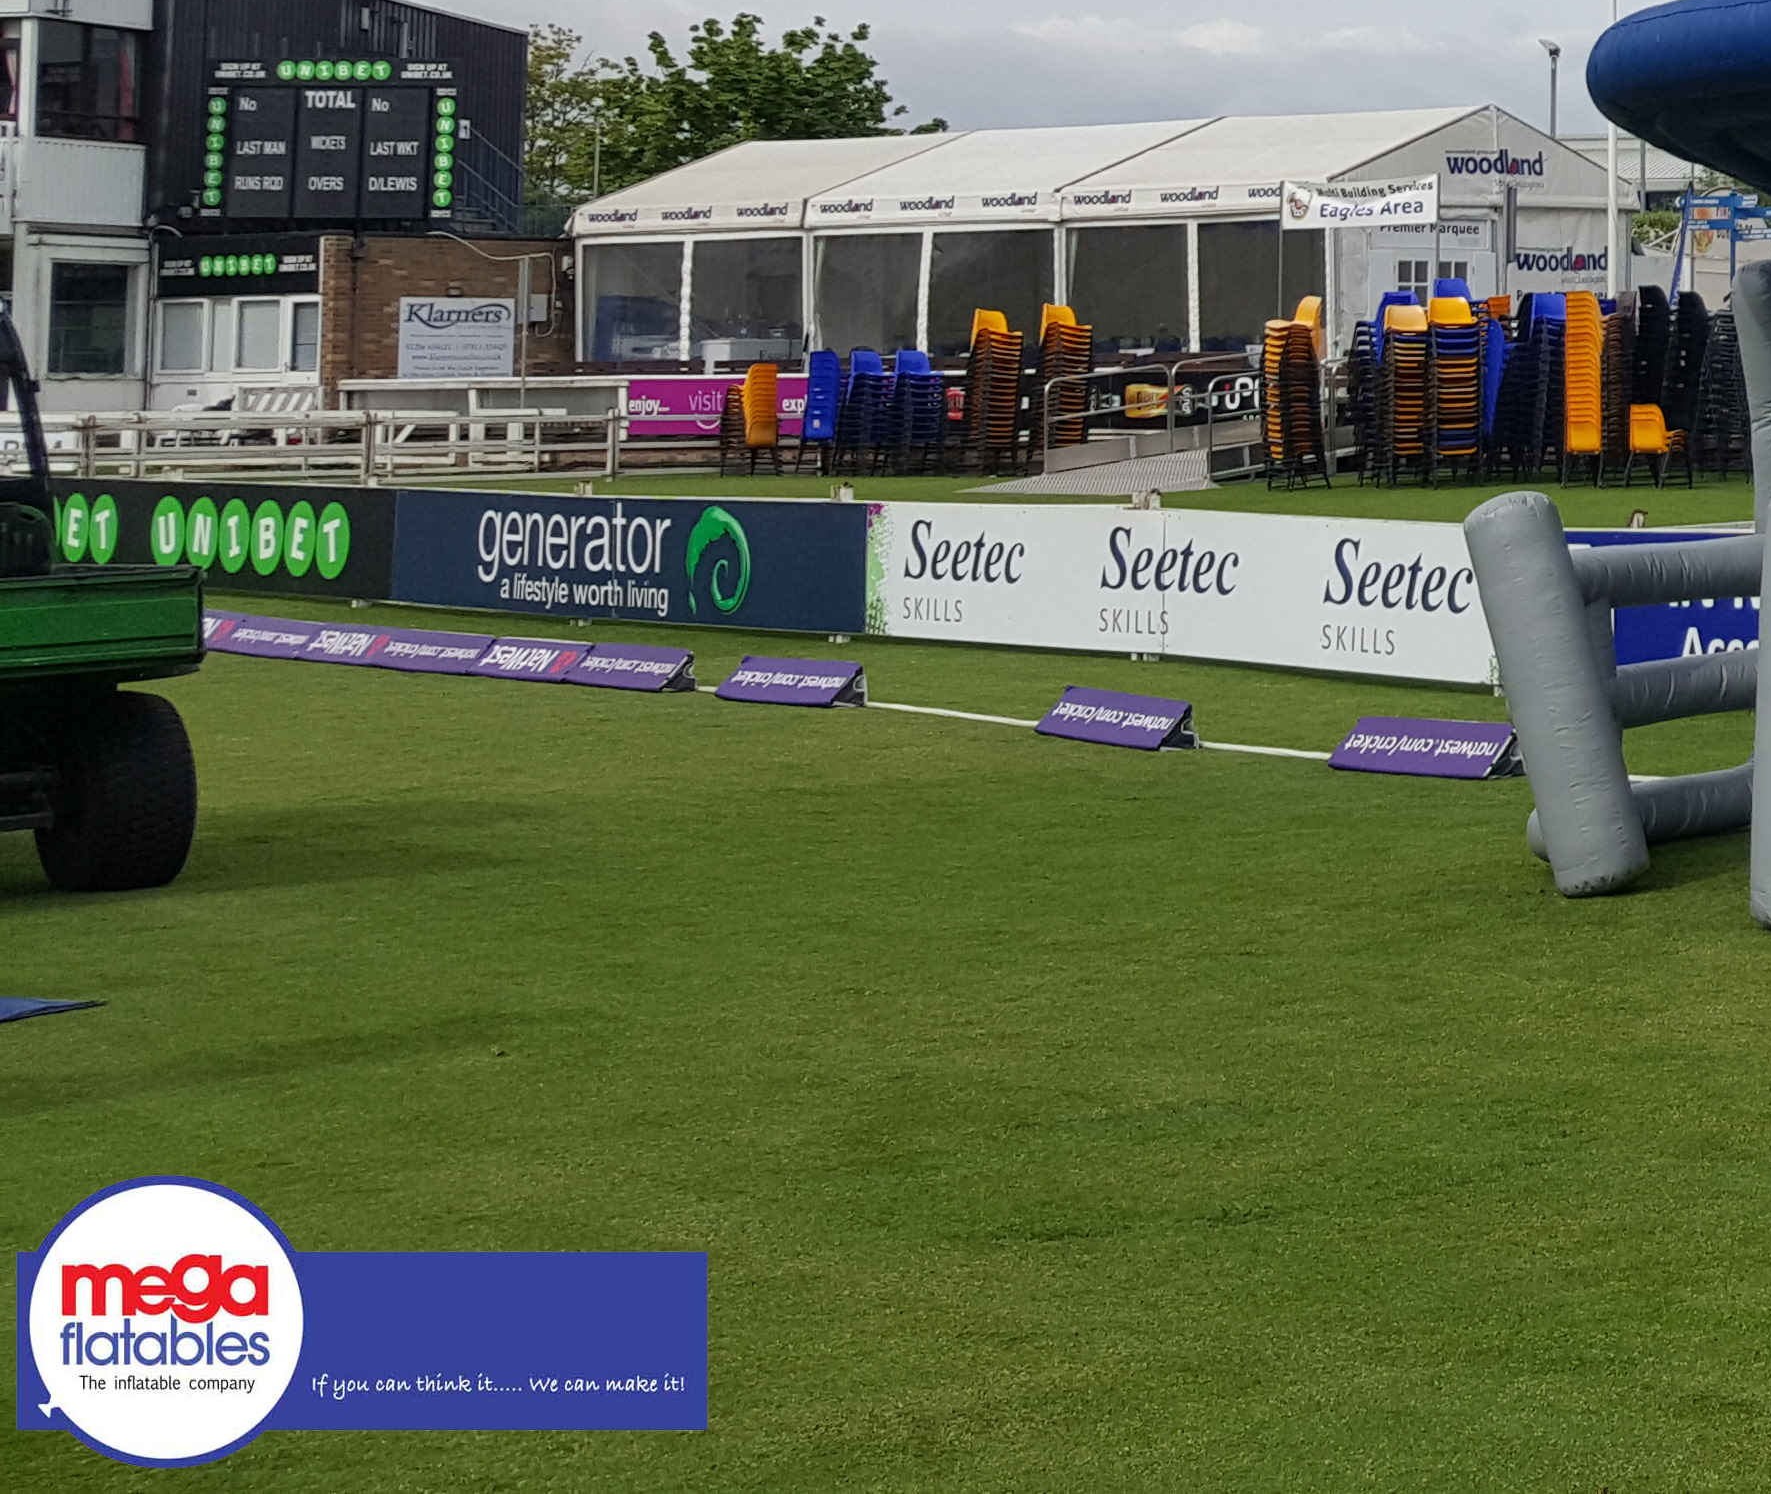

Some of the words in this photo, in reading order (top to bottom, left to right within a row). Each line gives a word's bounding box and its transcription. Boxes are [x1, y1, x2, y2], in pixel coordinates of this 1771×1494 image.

[279, 62, 388, 78] UNIBET
[238, 96, 258, 111] No
[305, 90, 356, 108] TOTAL
[371, 97, 390, 112] No
[236, 141, 261, 155] LAST
[262, 140, 286, 155] MAN
[370, 141, 396, 156] LAST
[397, 141, 419, 155] WKT
[1446, 149, 1544, 176] woodland
[234, 175, 261, 191] RUNS
[308, 176, 344, 191] OVERS
[368, 176, 418, 191] D/LEWIS
[1341, 186, 1386, 198] Building
[1388, 180, 1434, 194] Services
[900, 195, 955, 212] woodland
[981, 191, 1038, 208] woodland
[1073, 189, 1132, 206] woodland
[1160, 186, 1220, 203] woodland
[661, 206, 713, 221] woodland
[737, 202, 789, 217] woodland
[820, 198, 874, 214] woodland
[1320, 203, 1374, 221] Eagles
[1380, 200, 1424, 216] Area
[588, 209, 638, 223] woodland
[1380, 224, 1427, 235] Premier
[201, 256, 274, 275] UNIBET
[1516, 246, 1608, 272] woodland
[403, 302, 505, 328] Klarners
[688, 390, 723, 412] visit
[157, 511, 342, 563] UNIBET
[478, 502, 671, 583] generator
[904, 520, 1026, 586] Seetec
[1101, 526, 1240, 595] Seetec
[1323, 537, 1475, 614] Seetec
[500, 578, 510, 598] a
[513, 573, 569, 609] lifestyle
[573, 581, 624, 606] worth
[627, 577, 669, 617] living
[902, 596, 963, 623] SKILLS
[1099, 607, 1170, 636] SKILLS
[1321, 624, 1396, 656] SKILLS
[479, 644, 560, 673] NatWest
[731, 670, 846, 691] natwest.com/cricket
[1053, 701, 1176, 731] natwest.com/cricket
[1344, 731, 1499, 760] natwest.com/cricket
